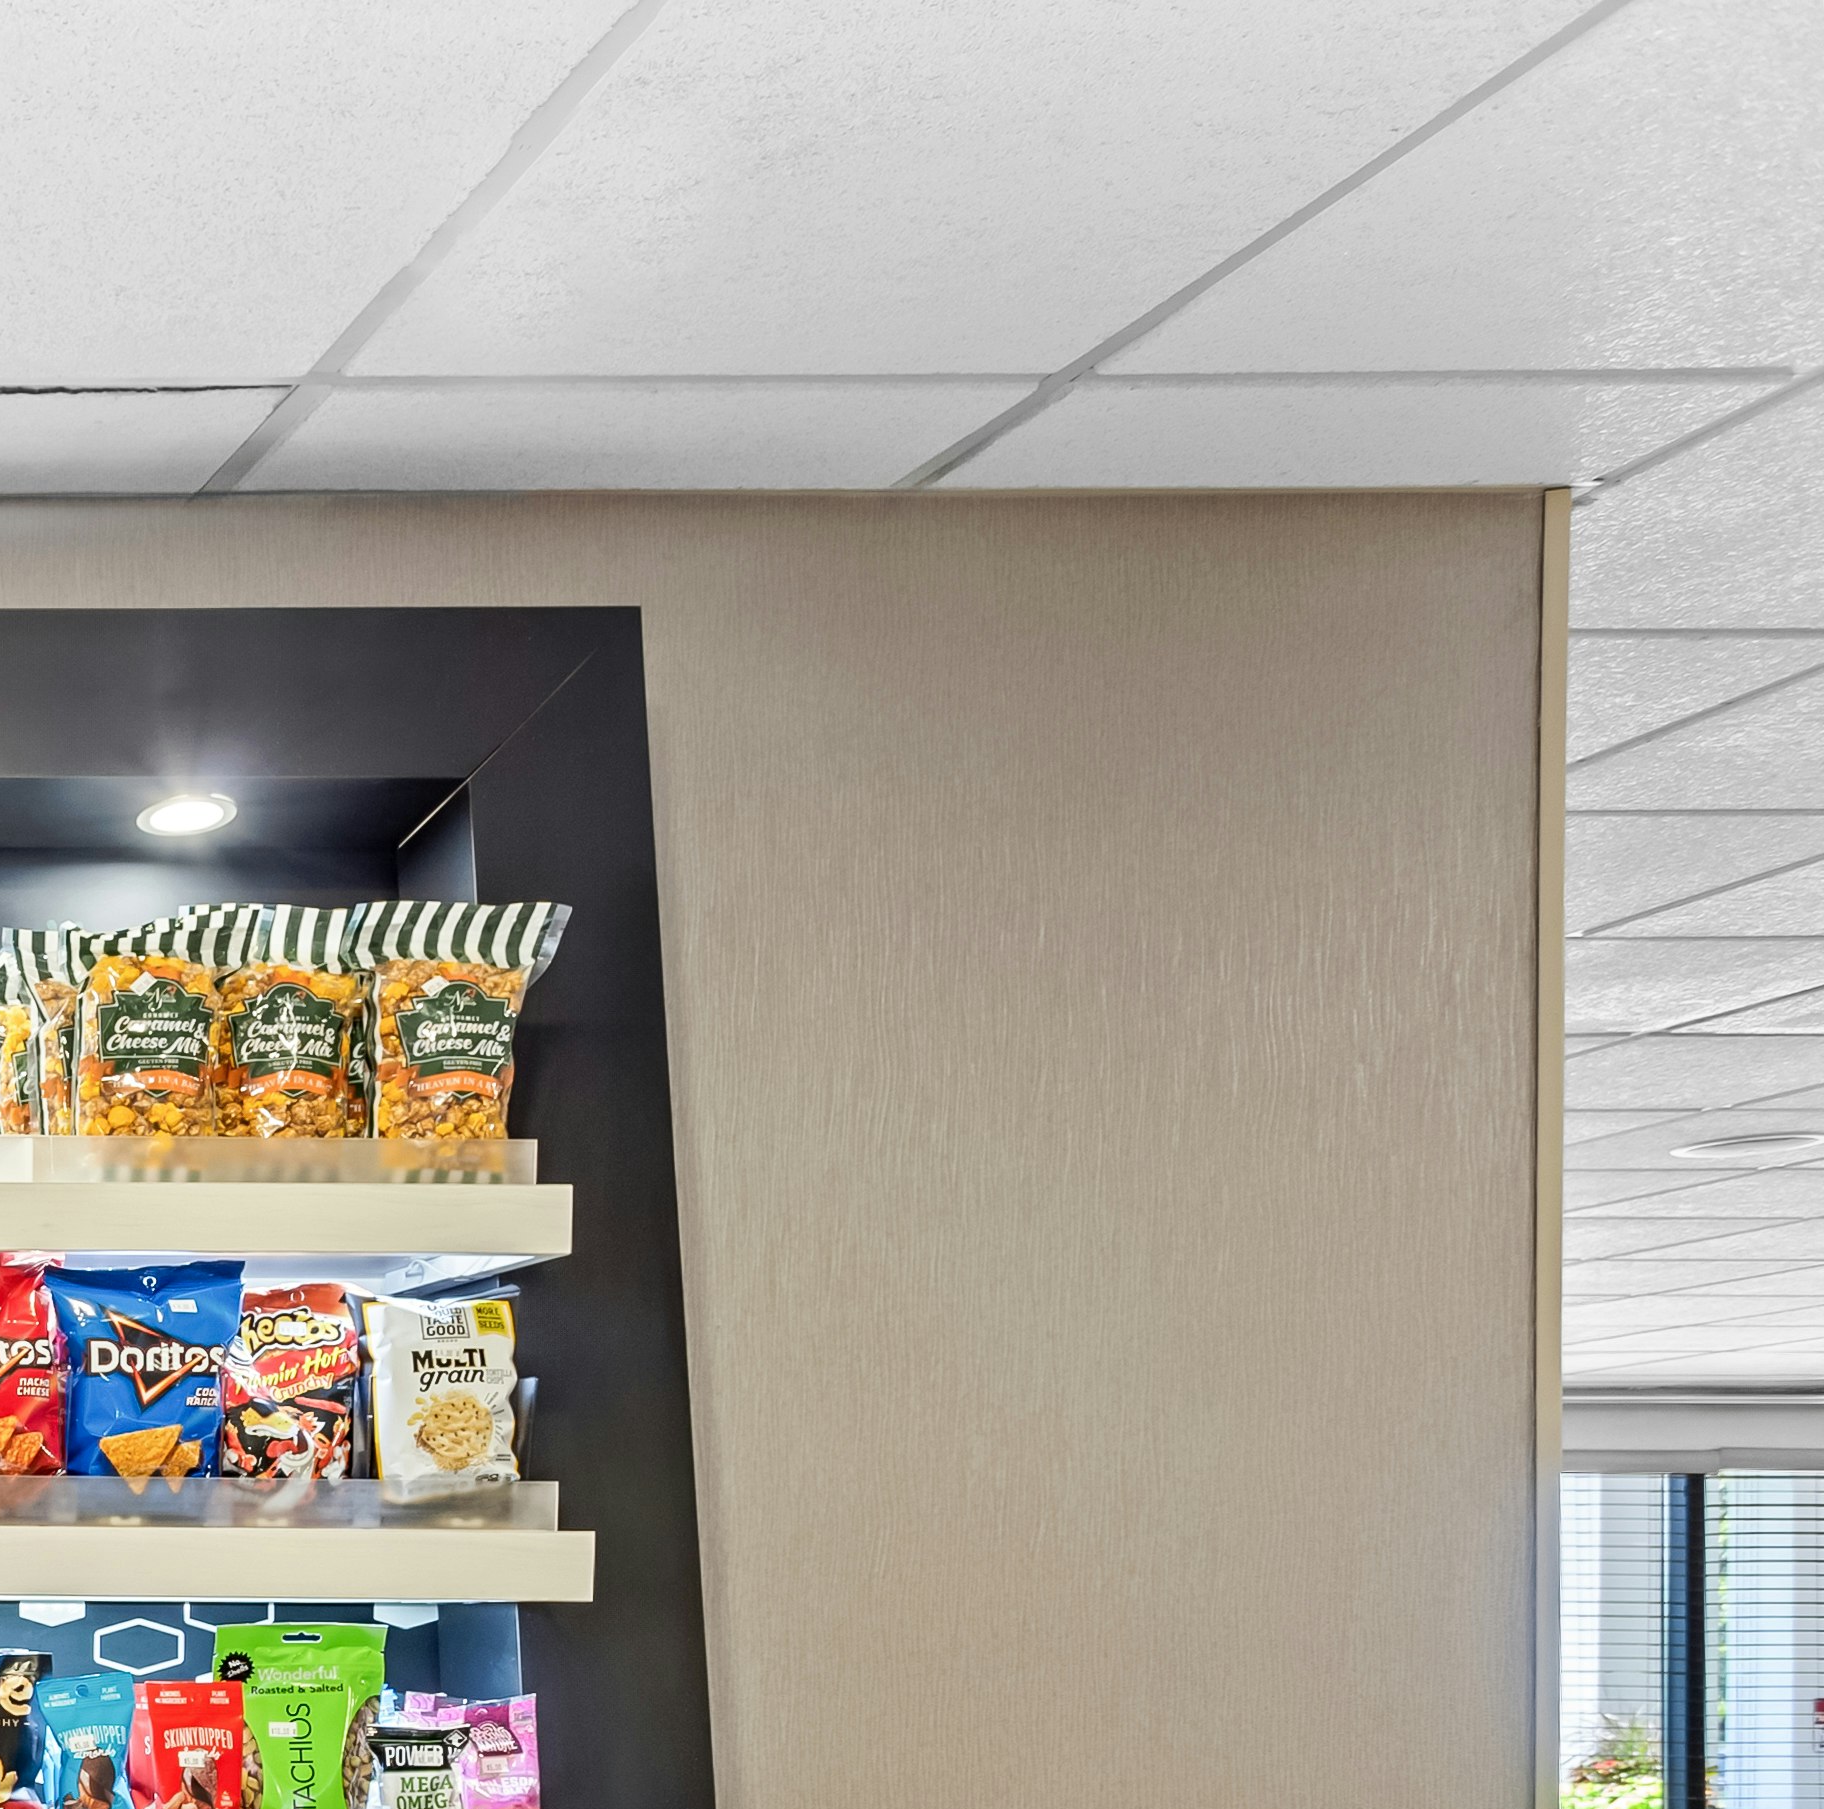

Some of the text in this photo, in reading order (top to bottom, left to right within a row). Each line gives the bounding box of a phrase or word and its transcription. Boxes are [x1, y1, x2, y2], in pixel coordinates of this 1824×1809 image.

[412, 1038, 506, 1057] Cheese Mix
[476, 1307, 501, 1317] MORE
[426, 1324, 466, 1337] GOOD
[301, 1346, 347, 1375] Hot
[19, 1377, 50, 1388] NACHO
[270, 1370, 335, 1403] Crunchy
[419, 1368, 485, 1393] grain
[16, 1387, 50, 1397] CHEESE
[257, 1664, 339, 1682] Wonderful
[163, 1726, 234, 1750] SKINNYDIPPED
[400, 1774, 453, 1794] MEGA
